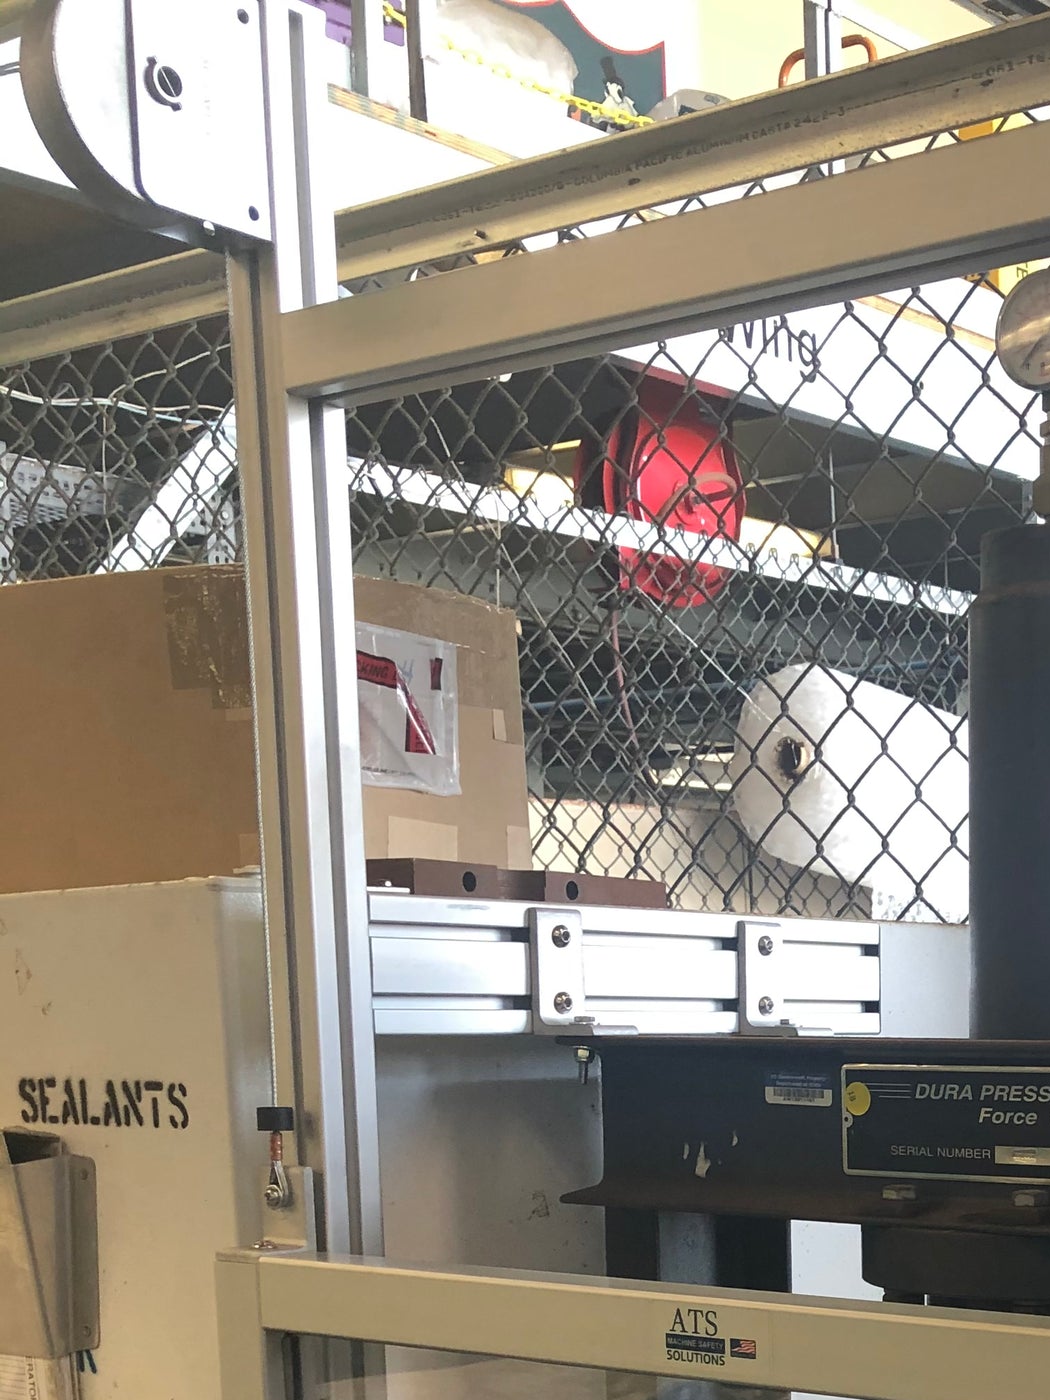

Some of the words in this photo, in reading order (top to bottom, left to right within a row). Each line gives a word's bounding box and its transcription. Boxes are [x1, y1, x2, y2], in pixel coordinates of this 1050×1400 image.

[357, 660, 388, 678] KING
[915, 1083, 973, 1101] DURA
[18, 1077, 189, 1129] SEALANTS
[978, 1107, 1038, 1125] Force
[890, 1145, 934, 1158] SERIAL
[937, 1147, 991, 1160] NUMBER
[669, 1307, 718, 1337] ATS
[667, 1337, 697, 1348] MACHINE
[699, 1339, 724, 1351] SAFETY
[666, 1349, 726, 1367] SOLUTIONS
